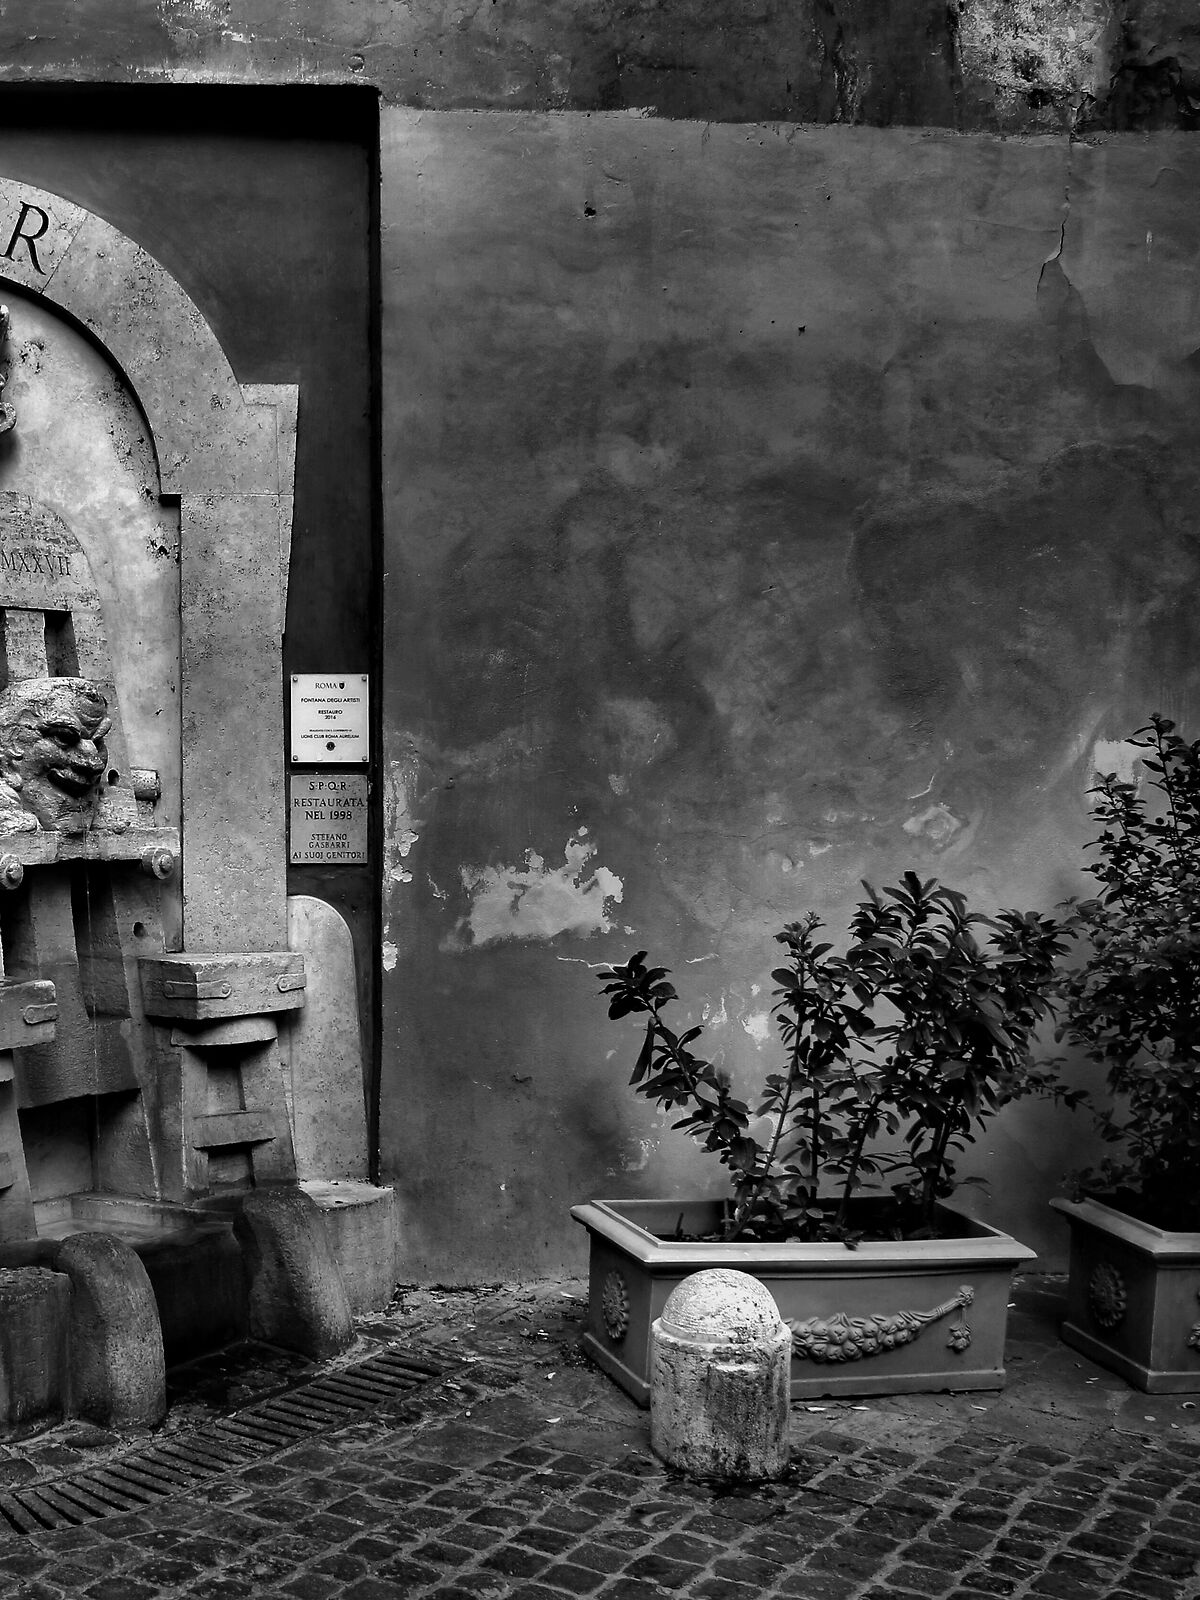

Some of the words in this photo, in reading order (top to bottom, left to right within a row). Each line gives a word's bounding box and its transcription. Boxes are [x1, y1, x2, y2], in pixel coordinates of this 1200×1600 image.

[294, 798, 365, 807] RESTAURATA
[305, 811, 325, 820] NEL
[330, 811, 352, 820] 1998
